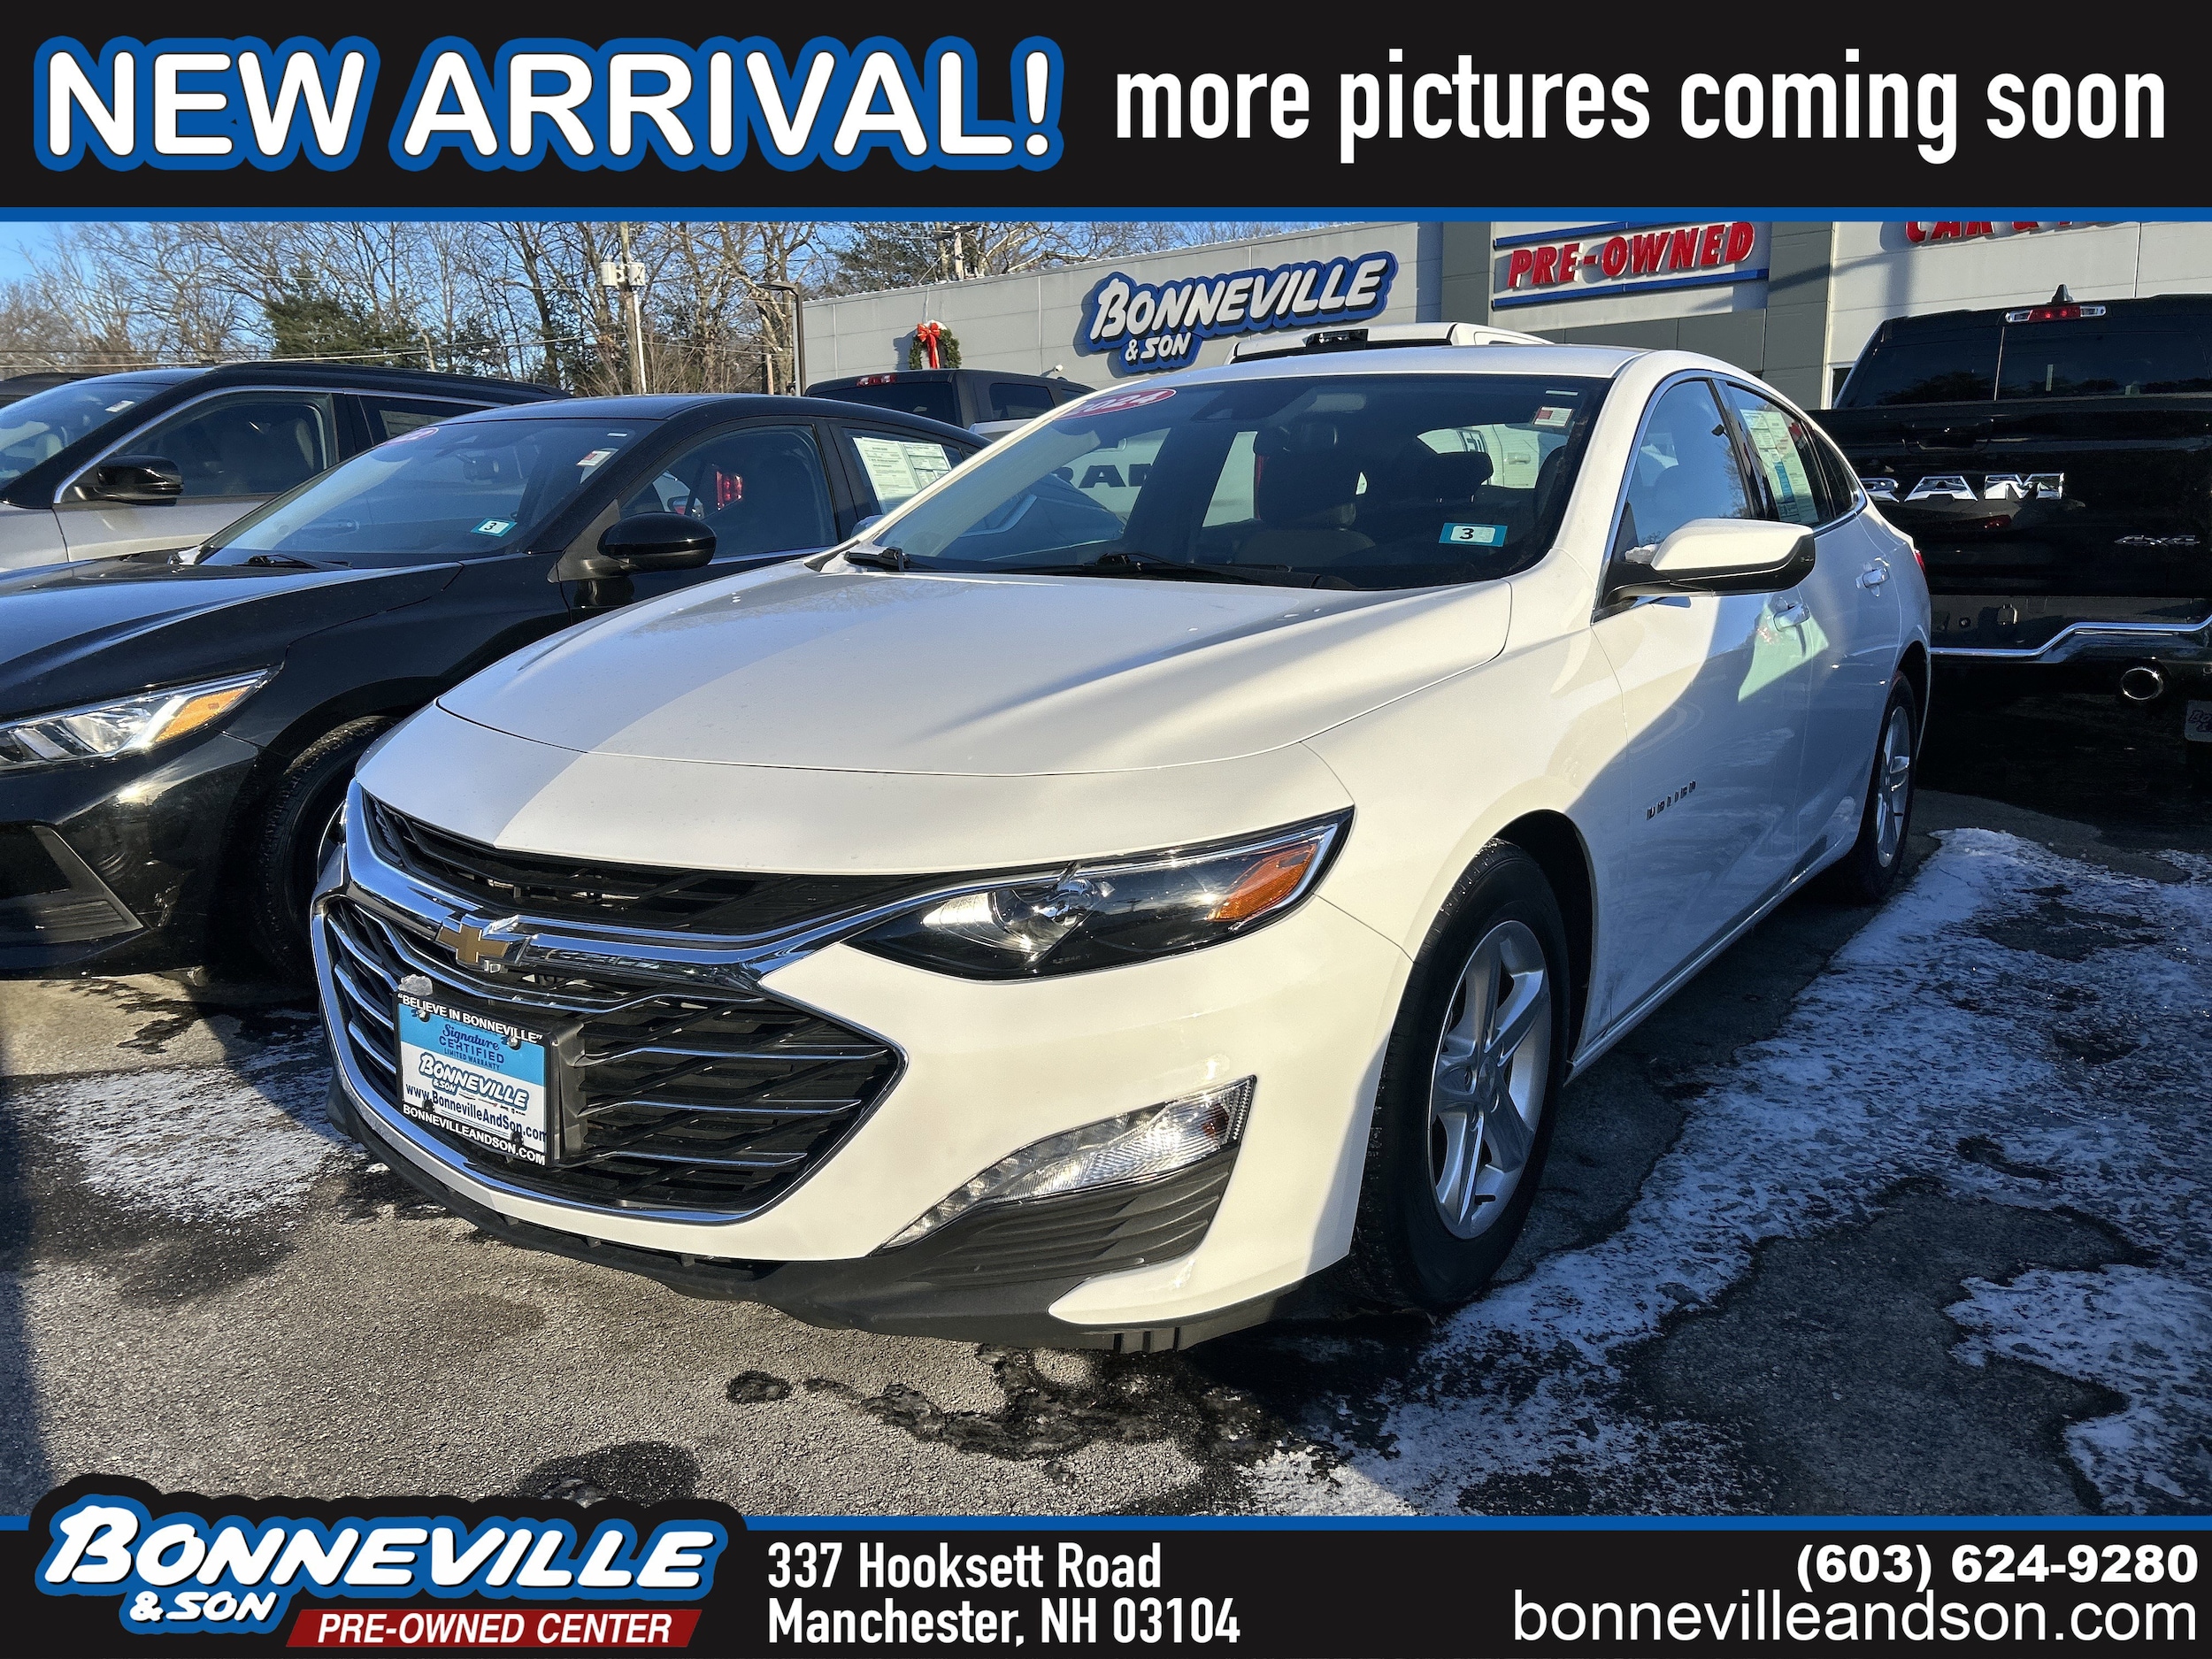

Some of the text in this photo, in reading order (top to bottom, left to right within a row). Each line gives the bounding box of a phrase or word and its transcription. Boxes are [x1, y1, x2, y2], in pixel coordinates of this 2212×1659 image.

[1508, 221, 1755, 288] PRE-OWNED
[1089, 258, 1387, 341] BONNEVILLE
[484, 522, 497, 531] 3
[1459, 527, 1475, 540] 3
[449, 1007, 462, 1022] IN
[439, 1035, 505, 1064] CERTIFIED
[442, 1023, 500, 1051] Signature
[419, 1053, 530, 1110] BONNEVILLE
[403, 1104, 546, 1166] BONNEVILLEANDSON.COM
